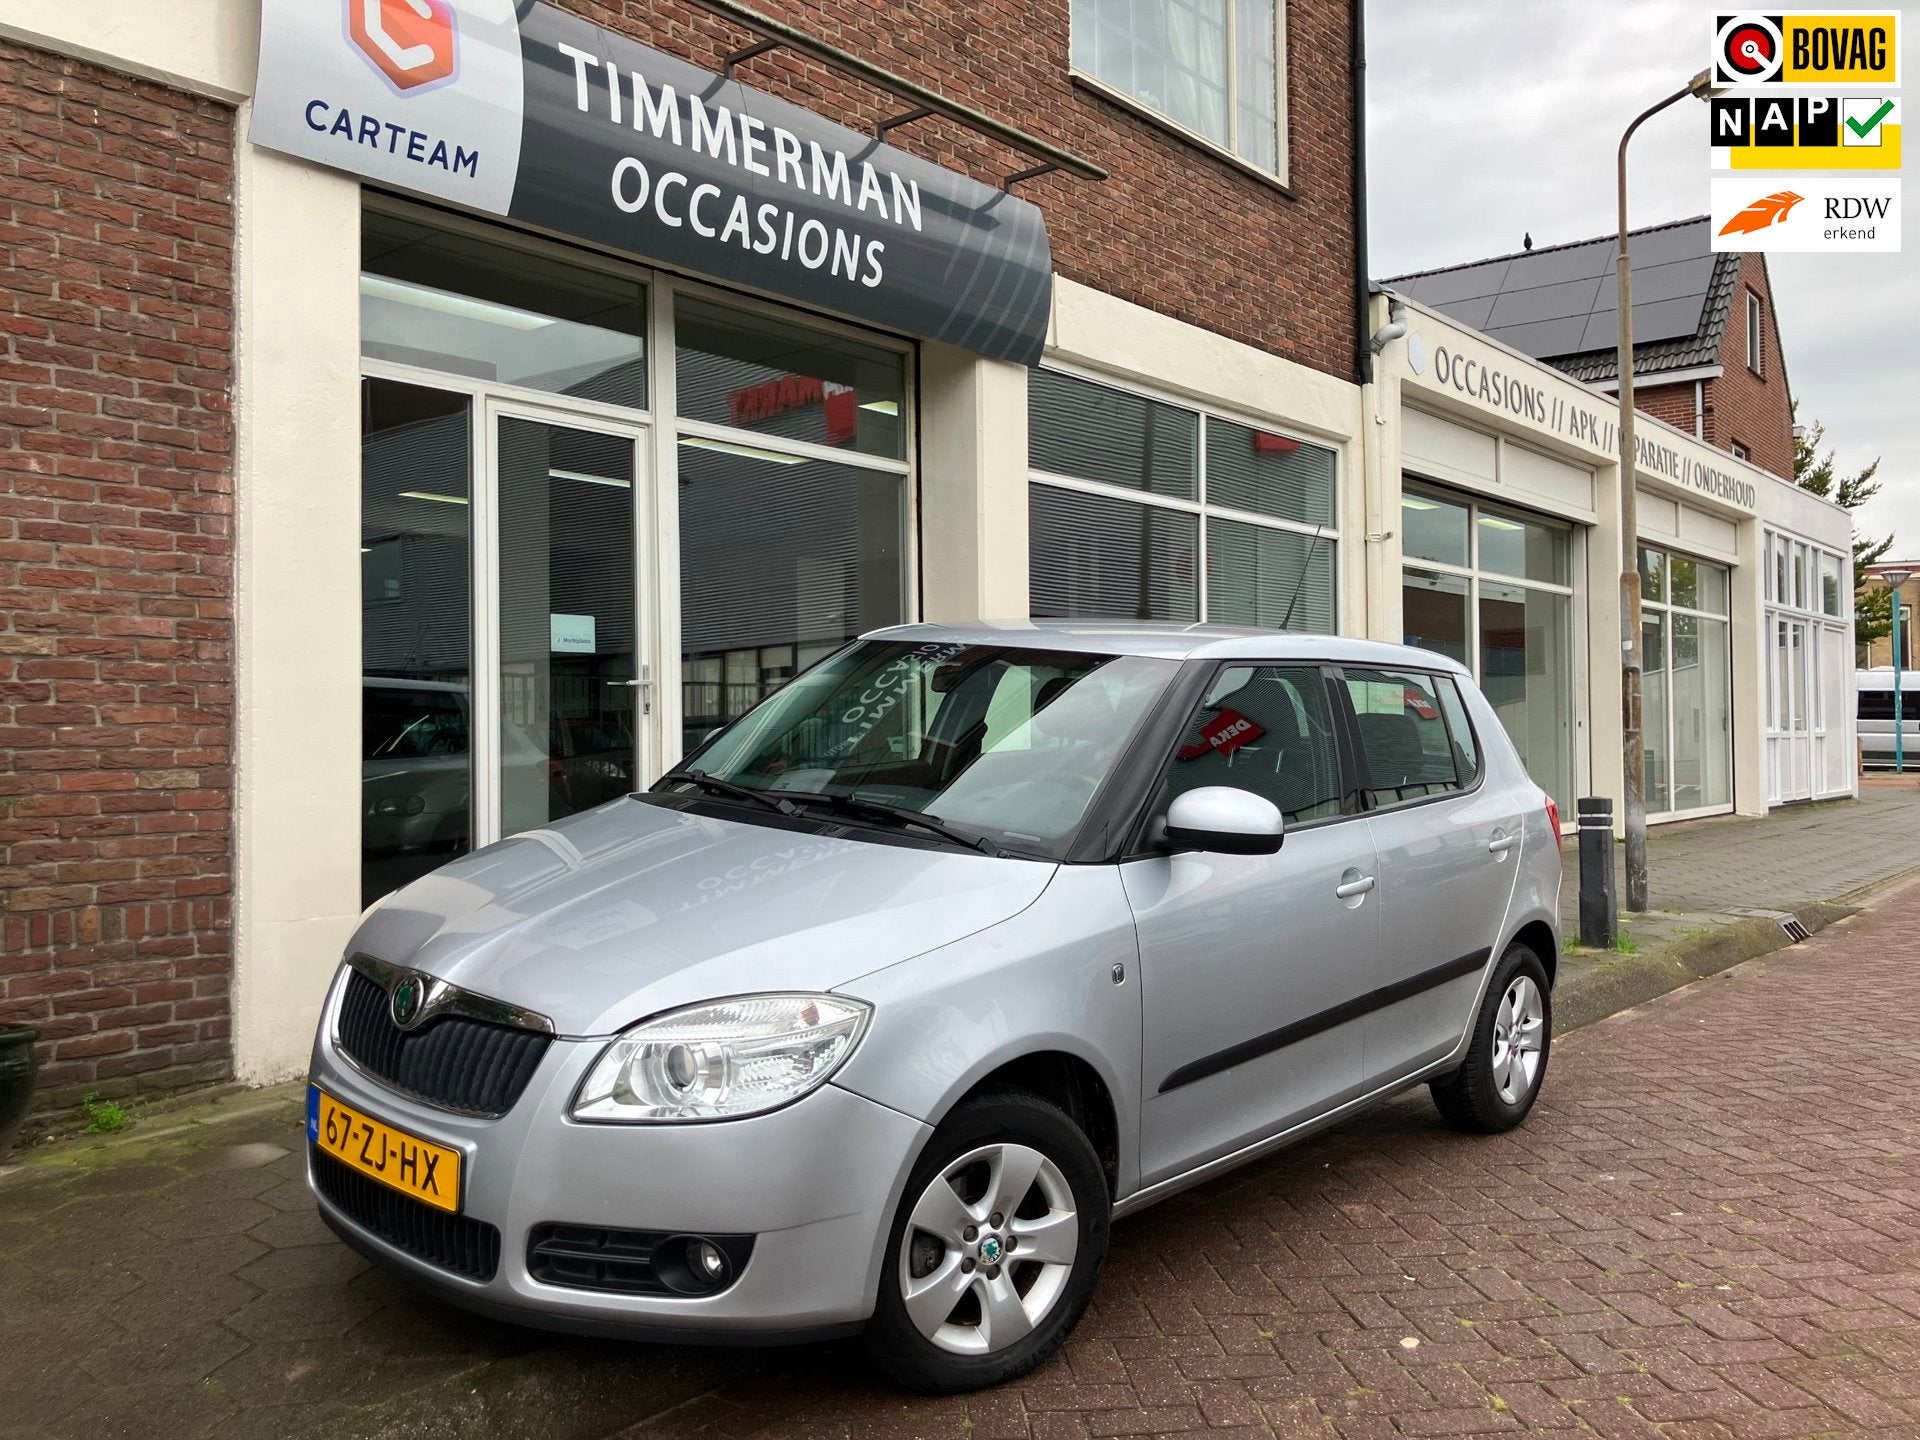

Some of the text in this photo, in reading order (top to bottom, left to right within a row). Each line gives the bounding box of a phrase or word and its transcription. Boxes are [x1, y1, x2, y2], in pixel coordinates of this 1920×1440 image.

[305, 99, 479, 178] CARTEAM
[558, 41, 924, 232] TIMMERMAN
[611, 156, 886, 288] OCCASIONS
[1435, 346, 1546, 424] OCCASIONS
[1570, 405, 1599, 446] APK
[1618, 427, 1680, 480] PARATIE
[1695, 462, 1756, 509] ONDERHOUD
[310, 1117, 319, 1133] NL
[326, 1106, 440, 1196] 67-ZJ-HX
